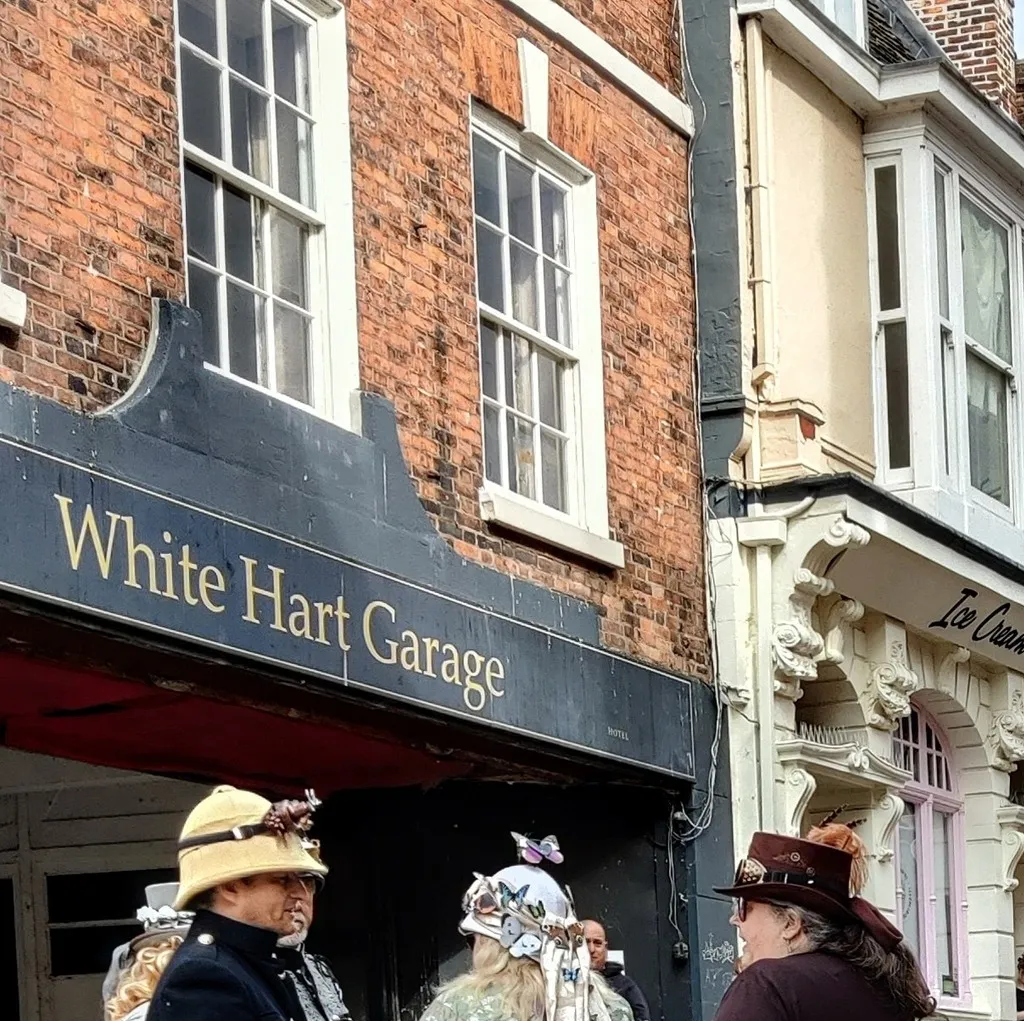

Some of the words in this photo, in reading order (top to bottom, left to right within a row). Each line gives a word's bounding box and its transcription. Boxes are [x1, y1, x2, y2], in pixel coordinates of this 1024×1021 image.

[53, 493, 226, 613] White
[239, 554, 351, 652] Hart
[362, 600, 505, 711] Garage
[929, 587, 978, 630] Ice
[607, 725, 630, 741] HOTEL
